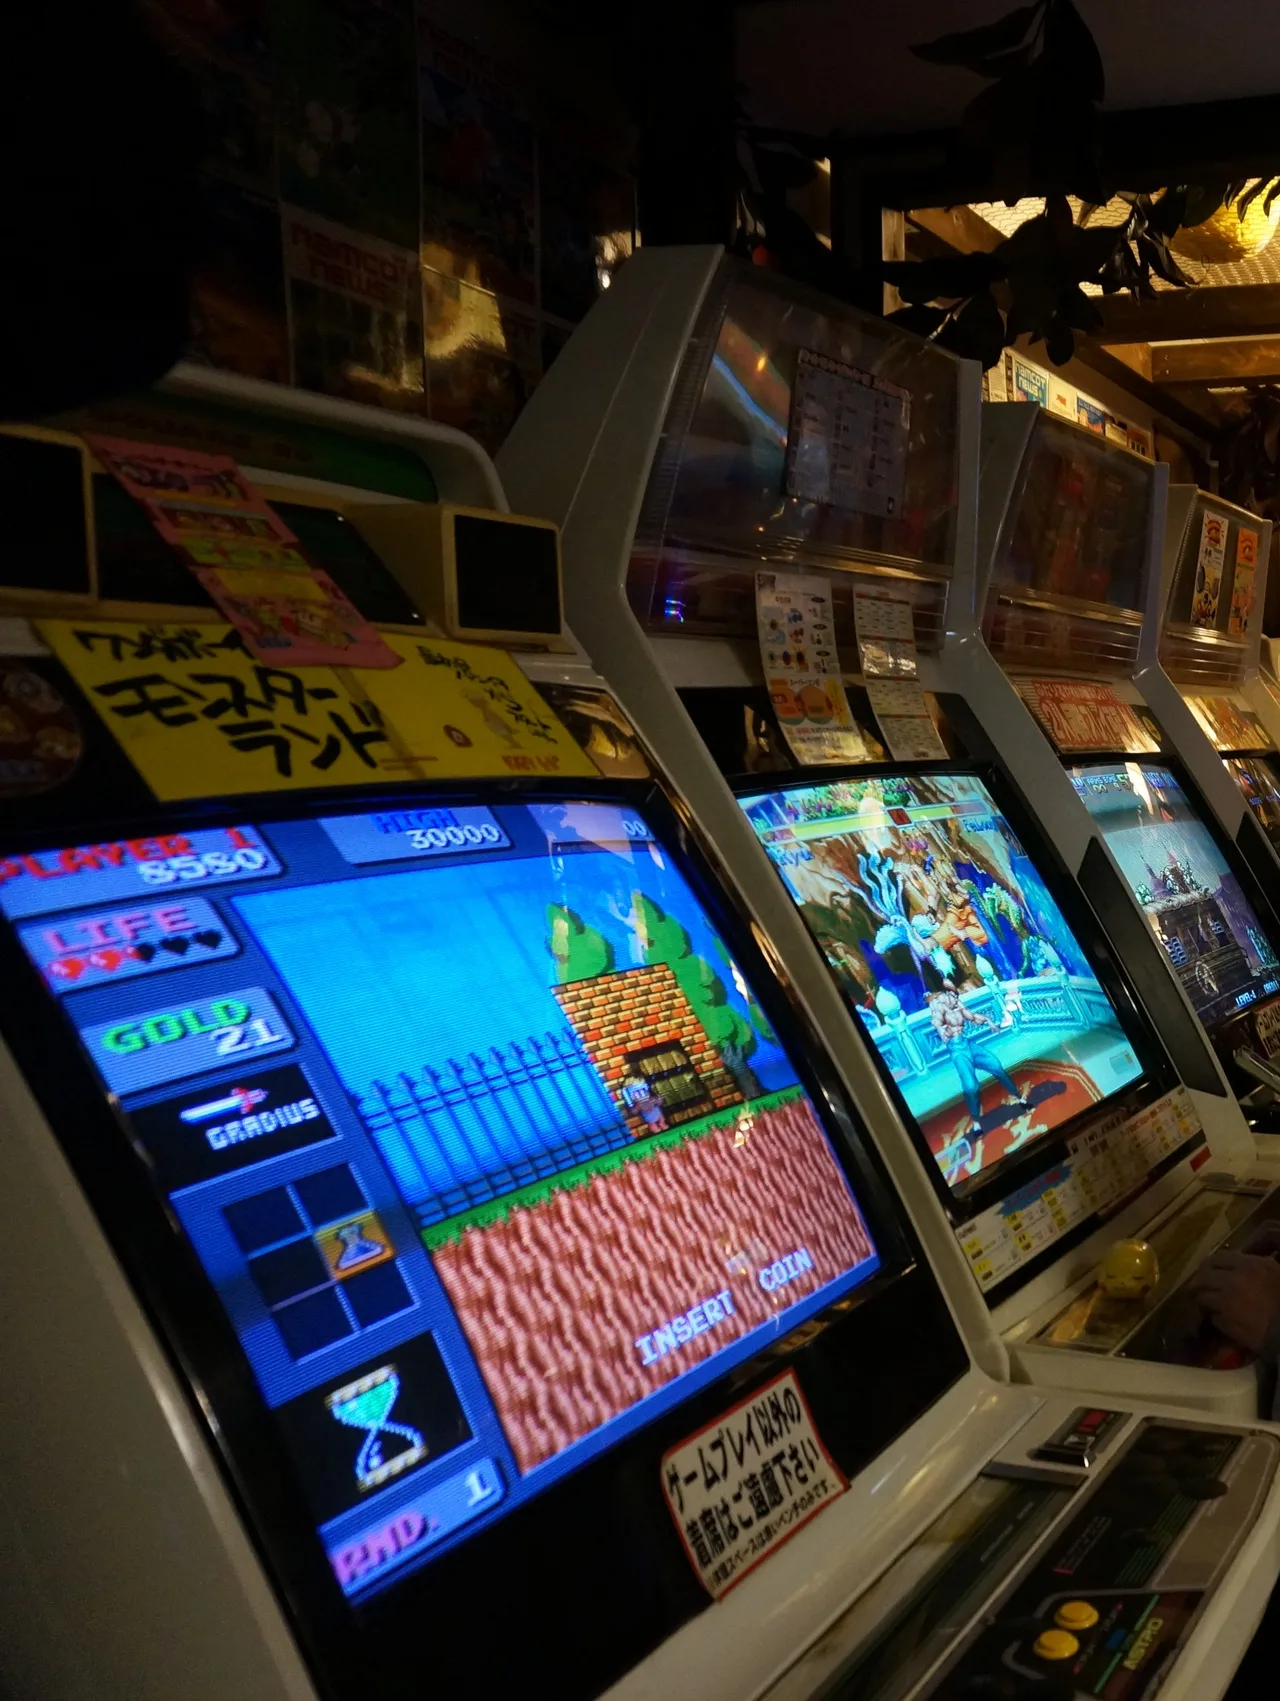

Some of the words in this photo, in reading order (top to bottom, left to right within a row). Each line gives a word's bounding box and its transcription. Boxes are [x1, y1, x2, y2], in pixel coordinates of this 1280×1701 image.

[217, 700, 385, 778] ランド
[44, 905, 198, 954] LIFE
[103, 1000, 251, 1054] GOLD
[212, 1019, 282, 1056] 21
[206, 1097, 320, 1151] GRADIUS
[636, 1289, 737, 1366] INSERT
[758, 1246, 815, 1293] COIN
[666, 1386, 802, 1516] ゲームプレイ以外の
[456, 1471, 486, 1508] 1
